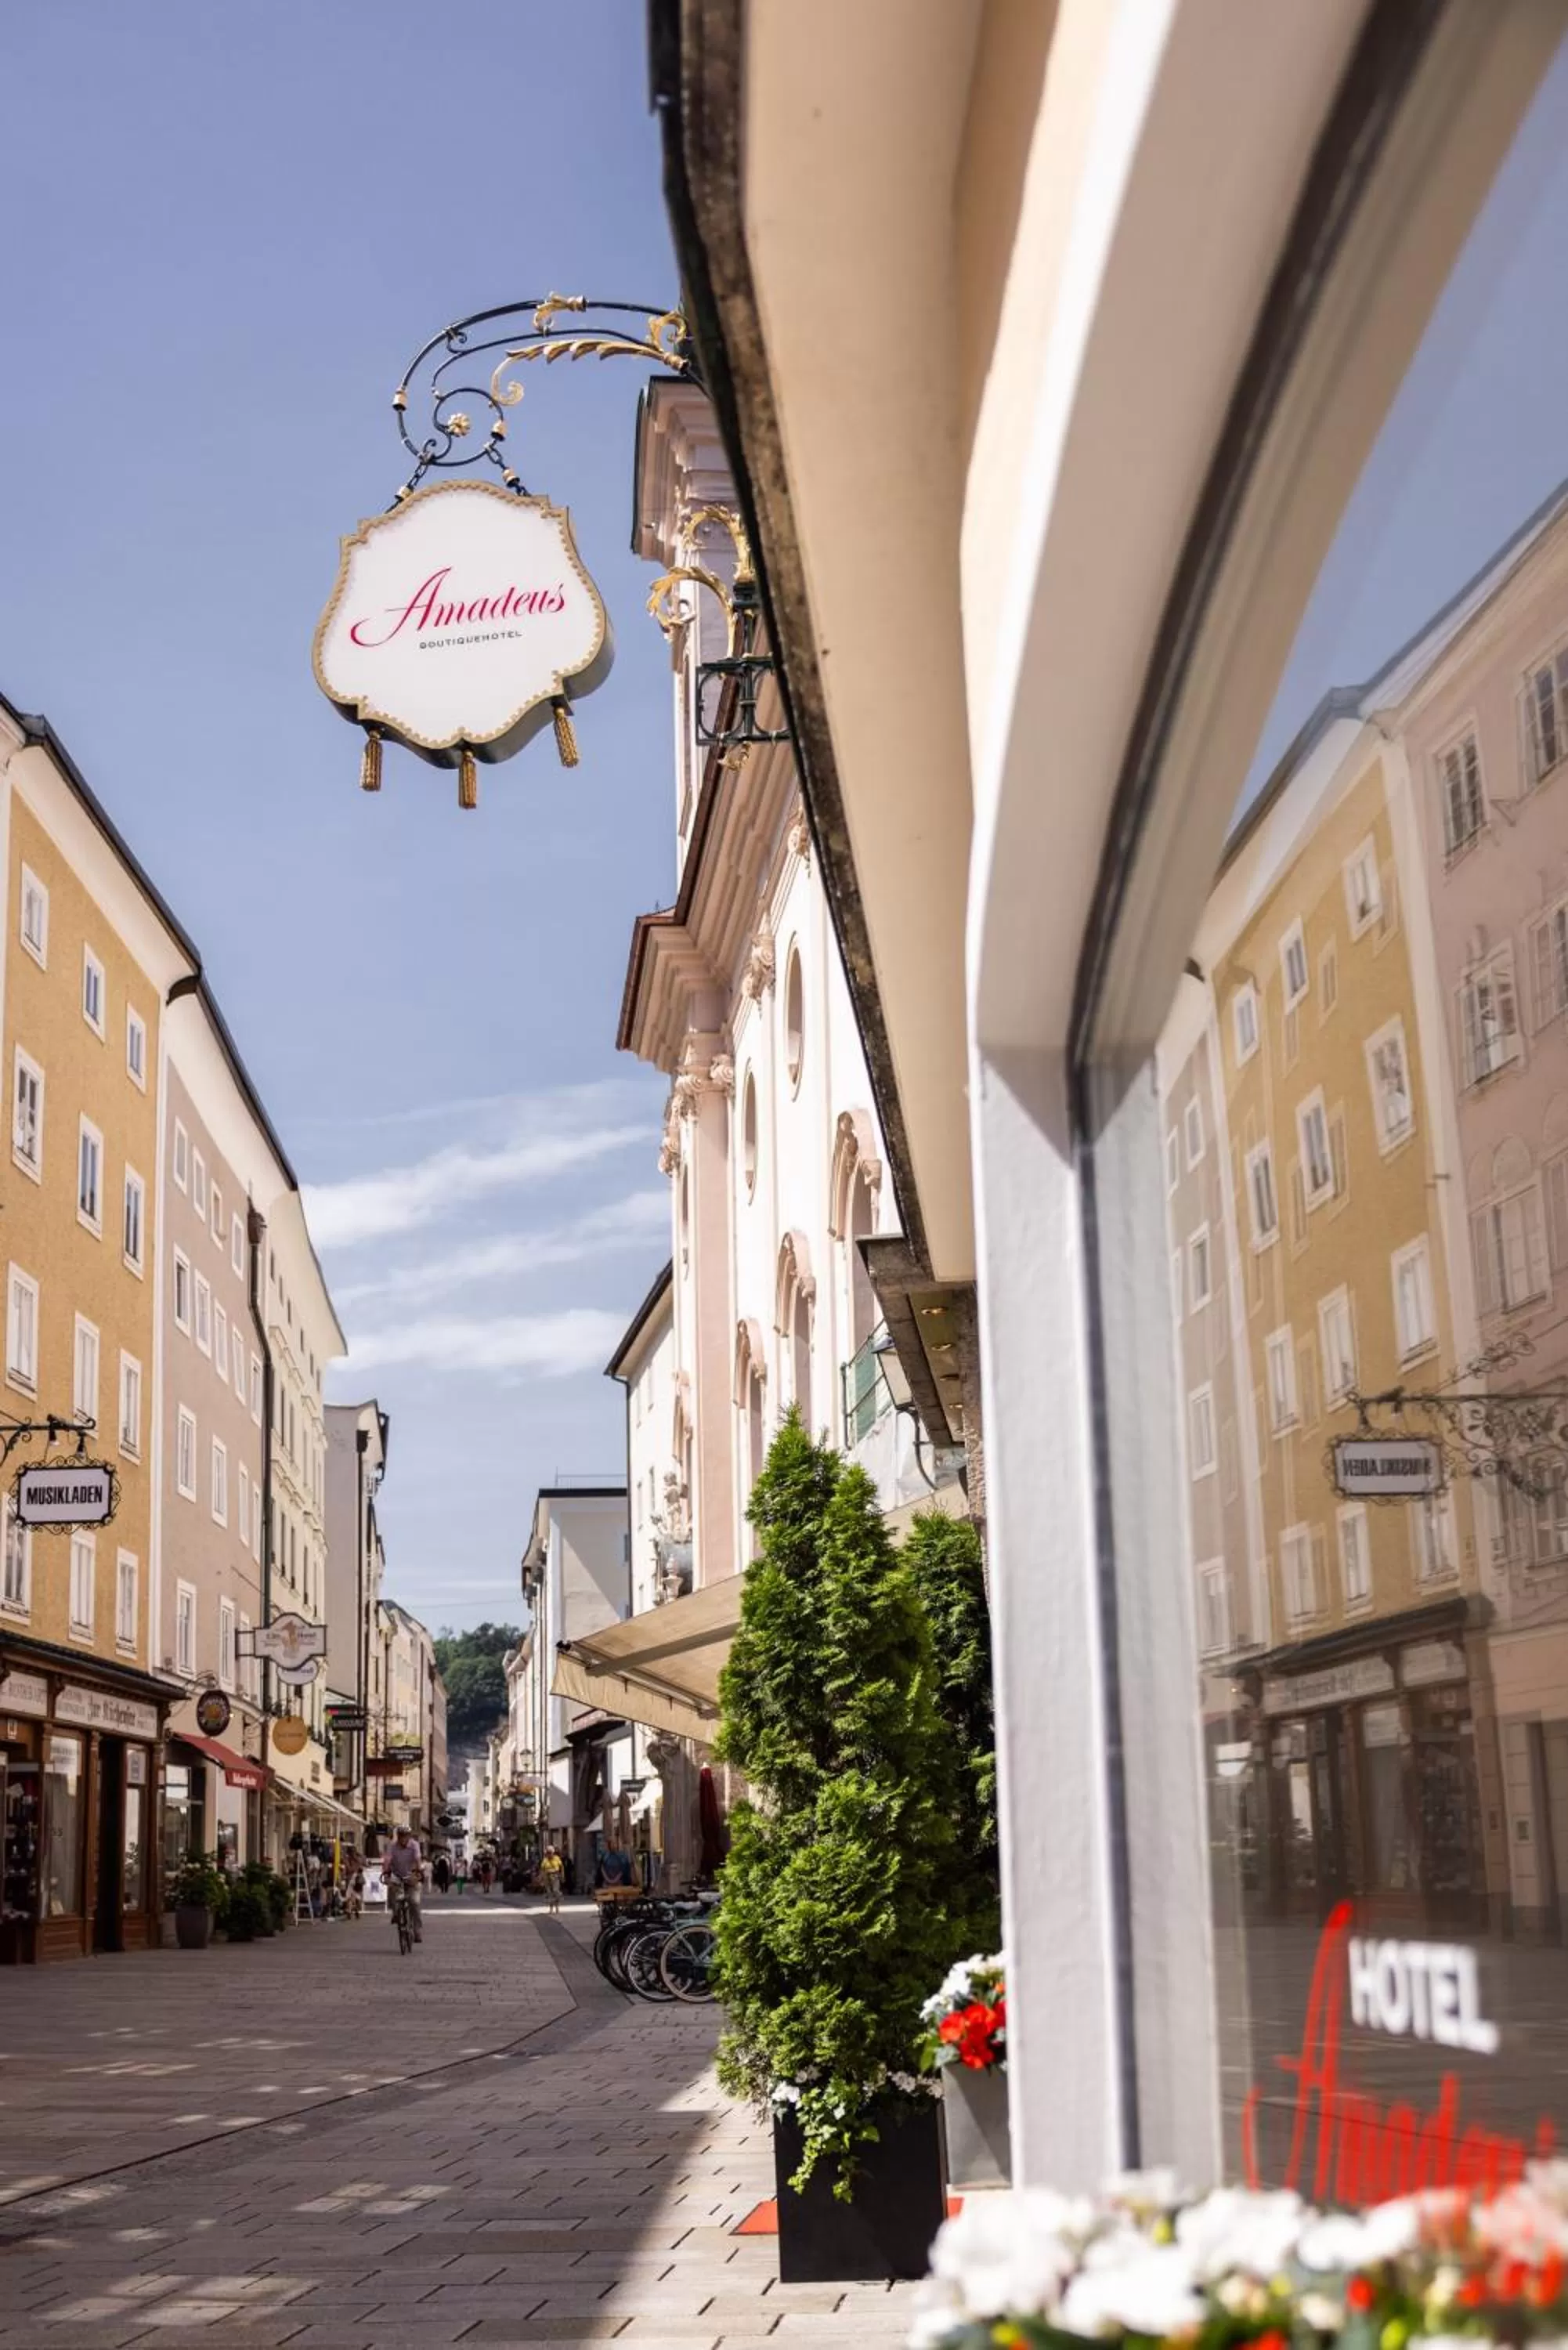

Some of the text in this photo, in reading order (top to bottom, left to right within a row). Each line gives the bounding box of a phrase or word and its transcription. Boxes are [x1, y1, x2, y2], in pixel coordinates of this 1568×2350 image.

[350, 566, 565, 647] Amadeus
[420, 630, 523, 649] BOUTIQUEHOTEL
[26, 1485, 103, 1505] MUSIKLADEN
[1349, 1937, 1500, 2054] HOTEL
